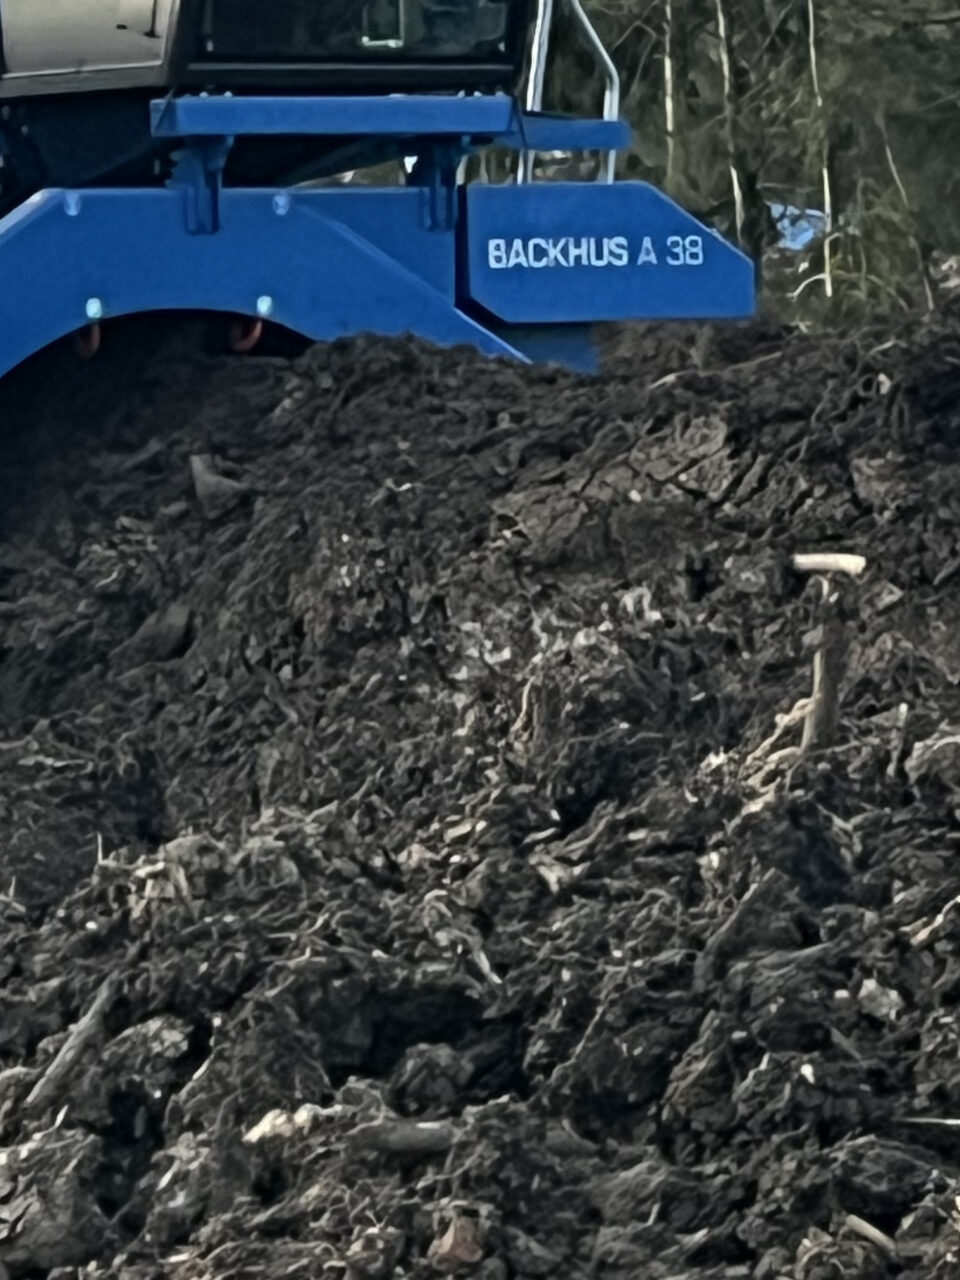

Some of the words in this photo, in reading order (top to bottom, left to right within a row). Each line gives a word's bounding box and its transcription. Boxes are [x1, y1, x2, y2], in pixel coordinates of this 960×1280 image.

[487, 236, 629, 269] BACKHUS
[637, 235, 658, 266] A
[666, 235, 703, 266] 38
